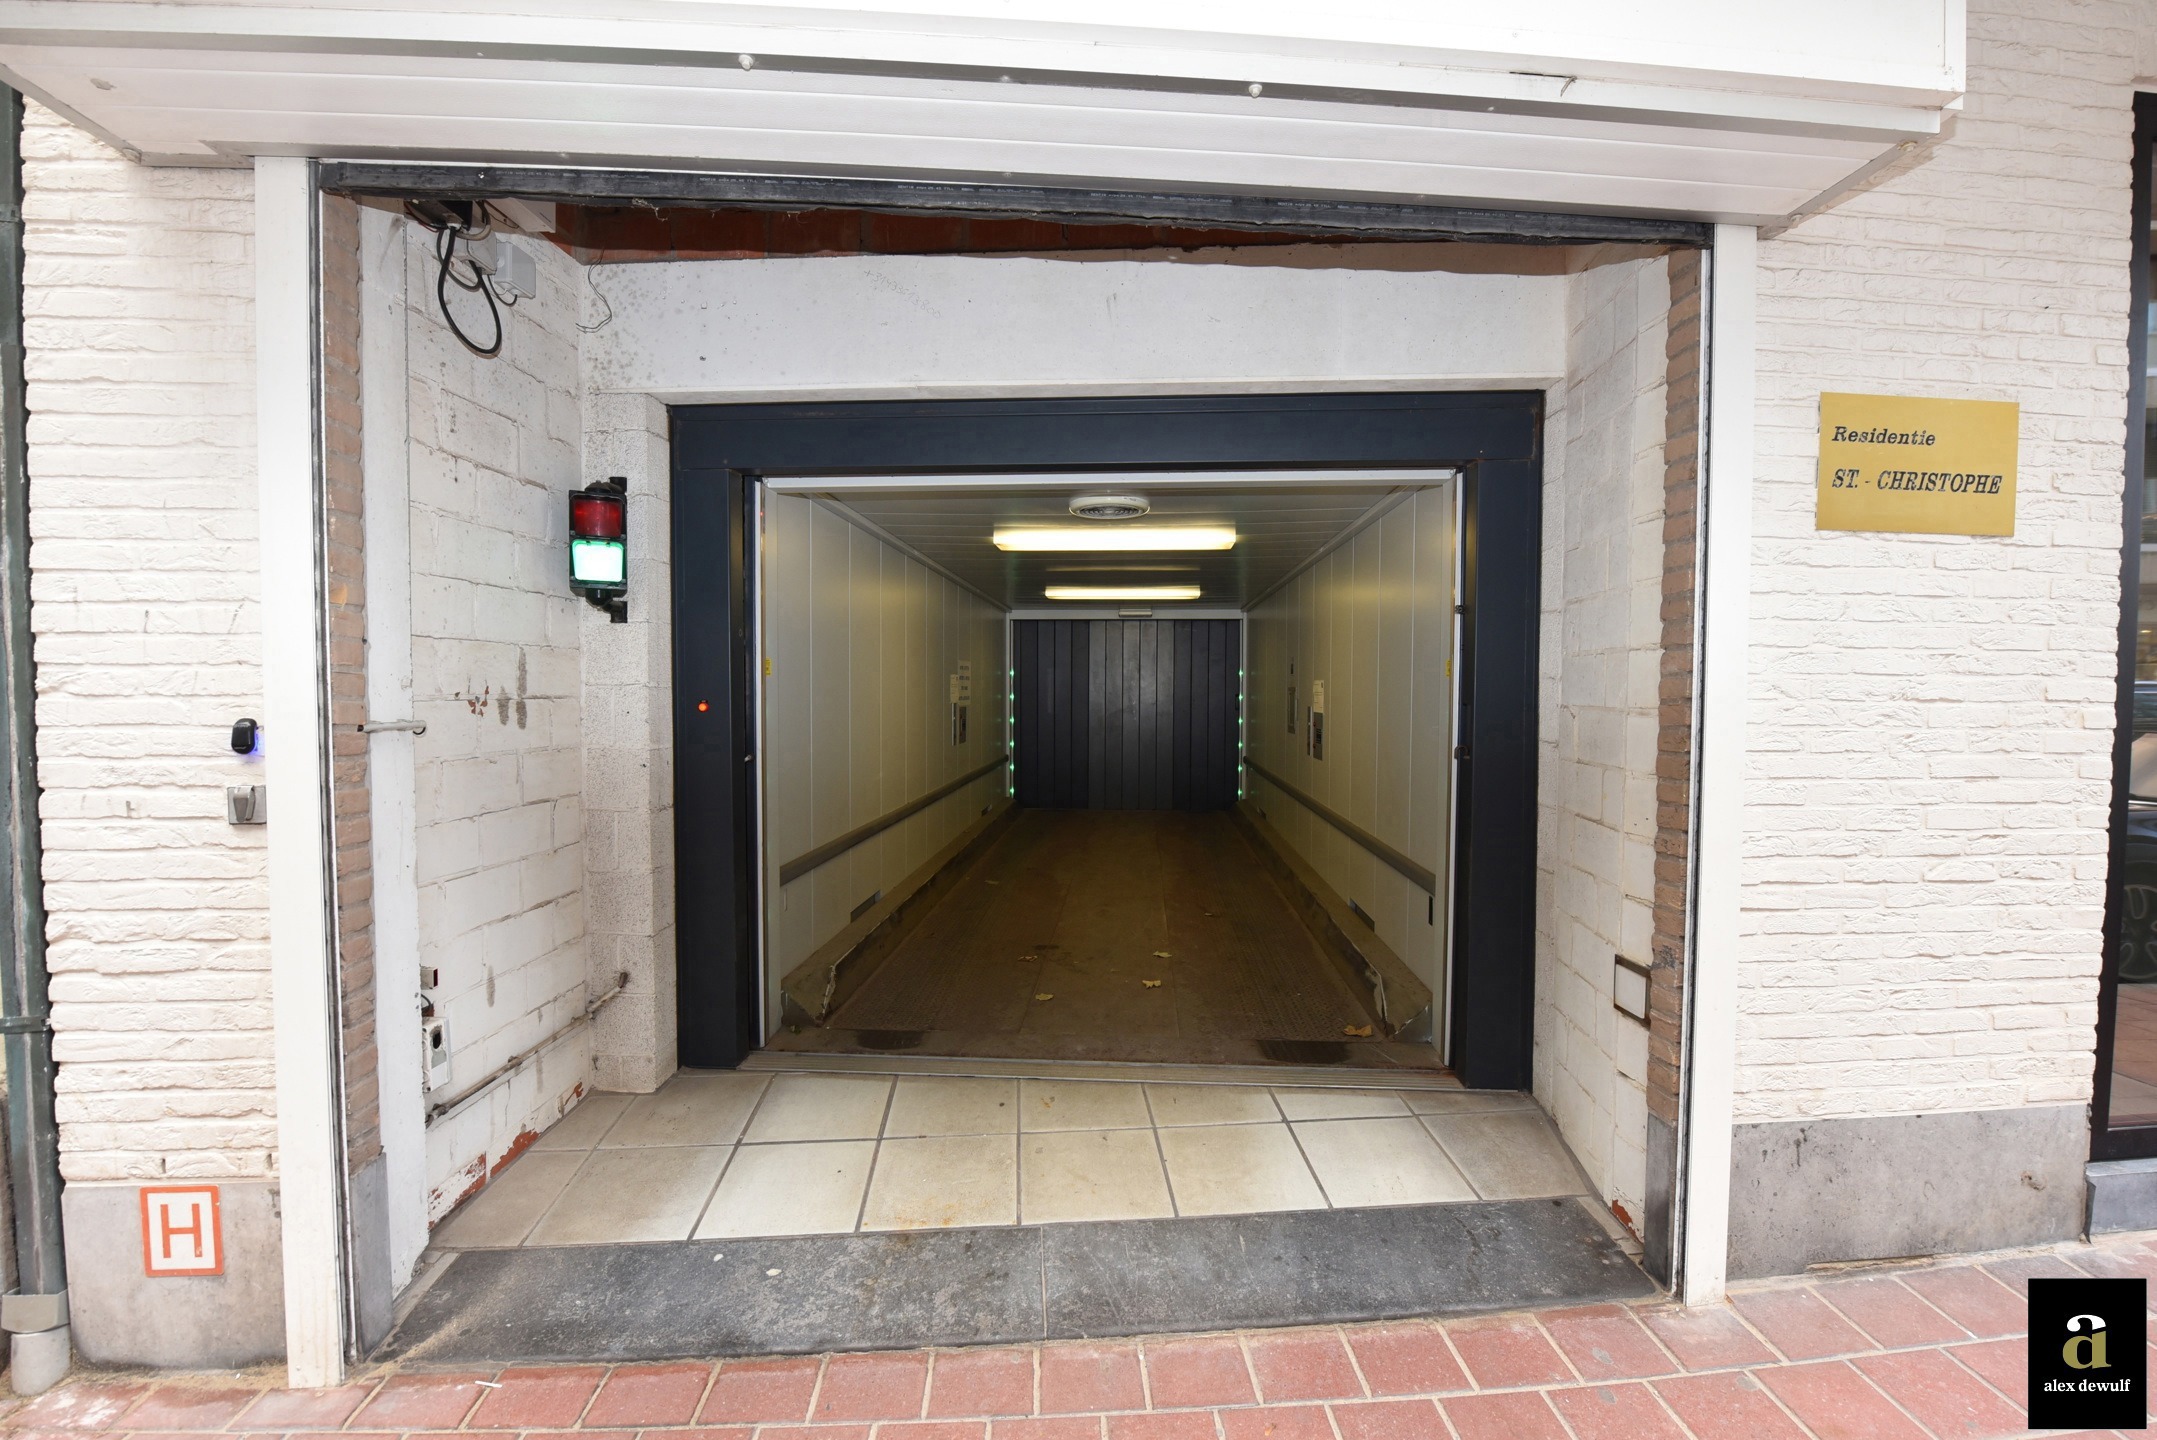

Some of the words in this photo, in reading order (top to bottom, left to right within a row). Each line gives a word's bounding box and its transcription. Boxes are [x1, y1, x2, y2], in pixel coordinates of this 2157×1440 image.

[1831, 425, 1936, 446] Residentie
[1877, 470, 2002, 495] CHRISTOPHE
[160, 1203, 203, 1259] H
